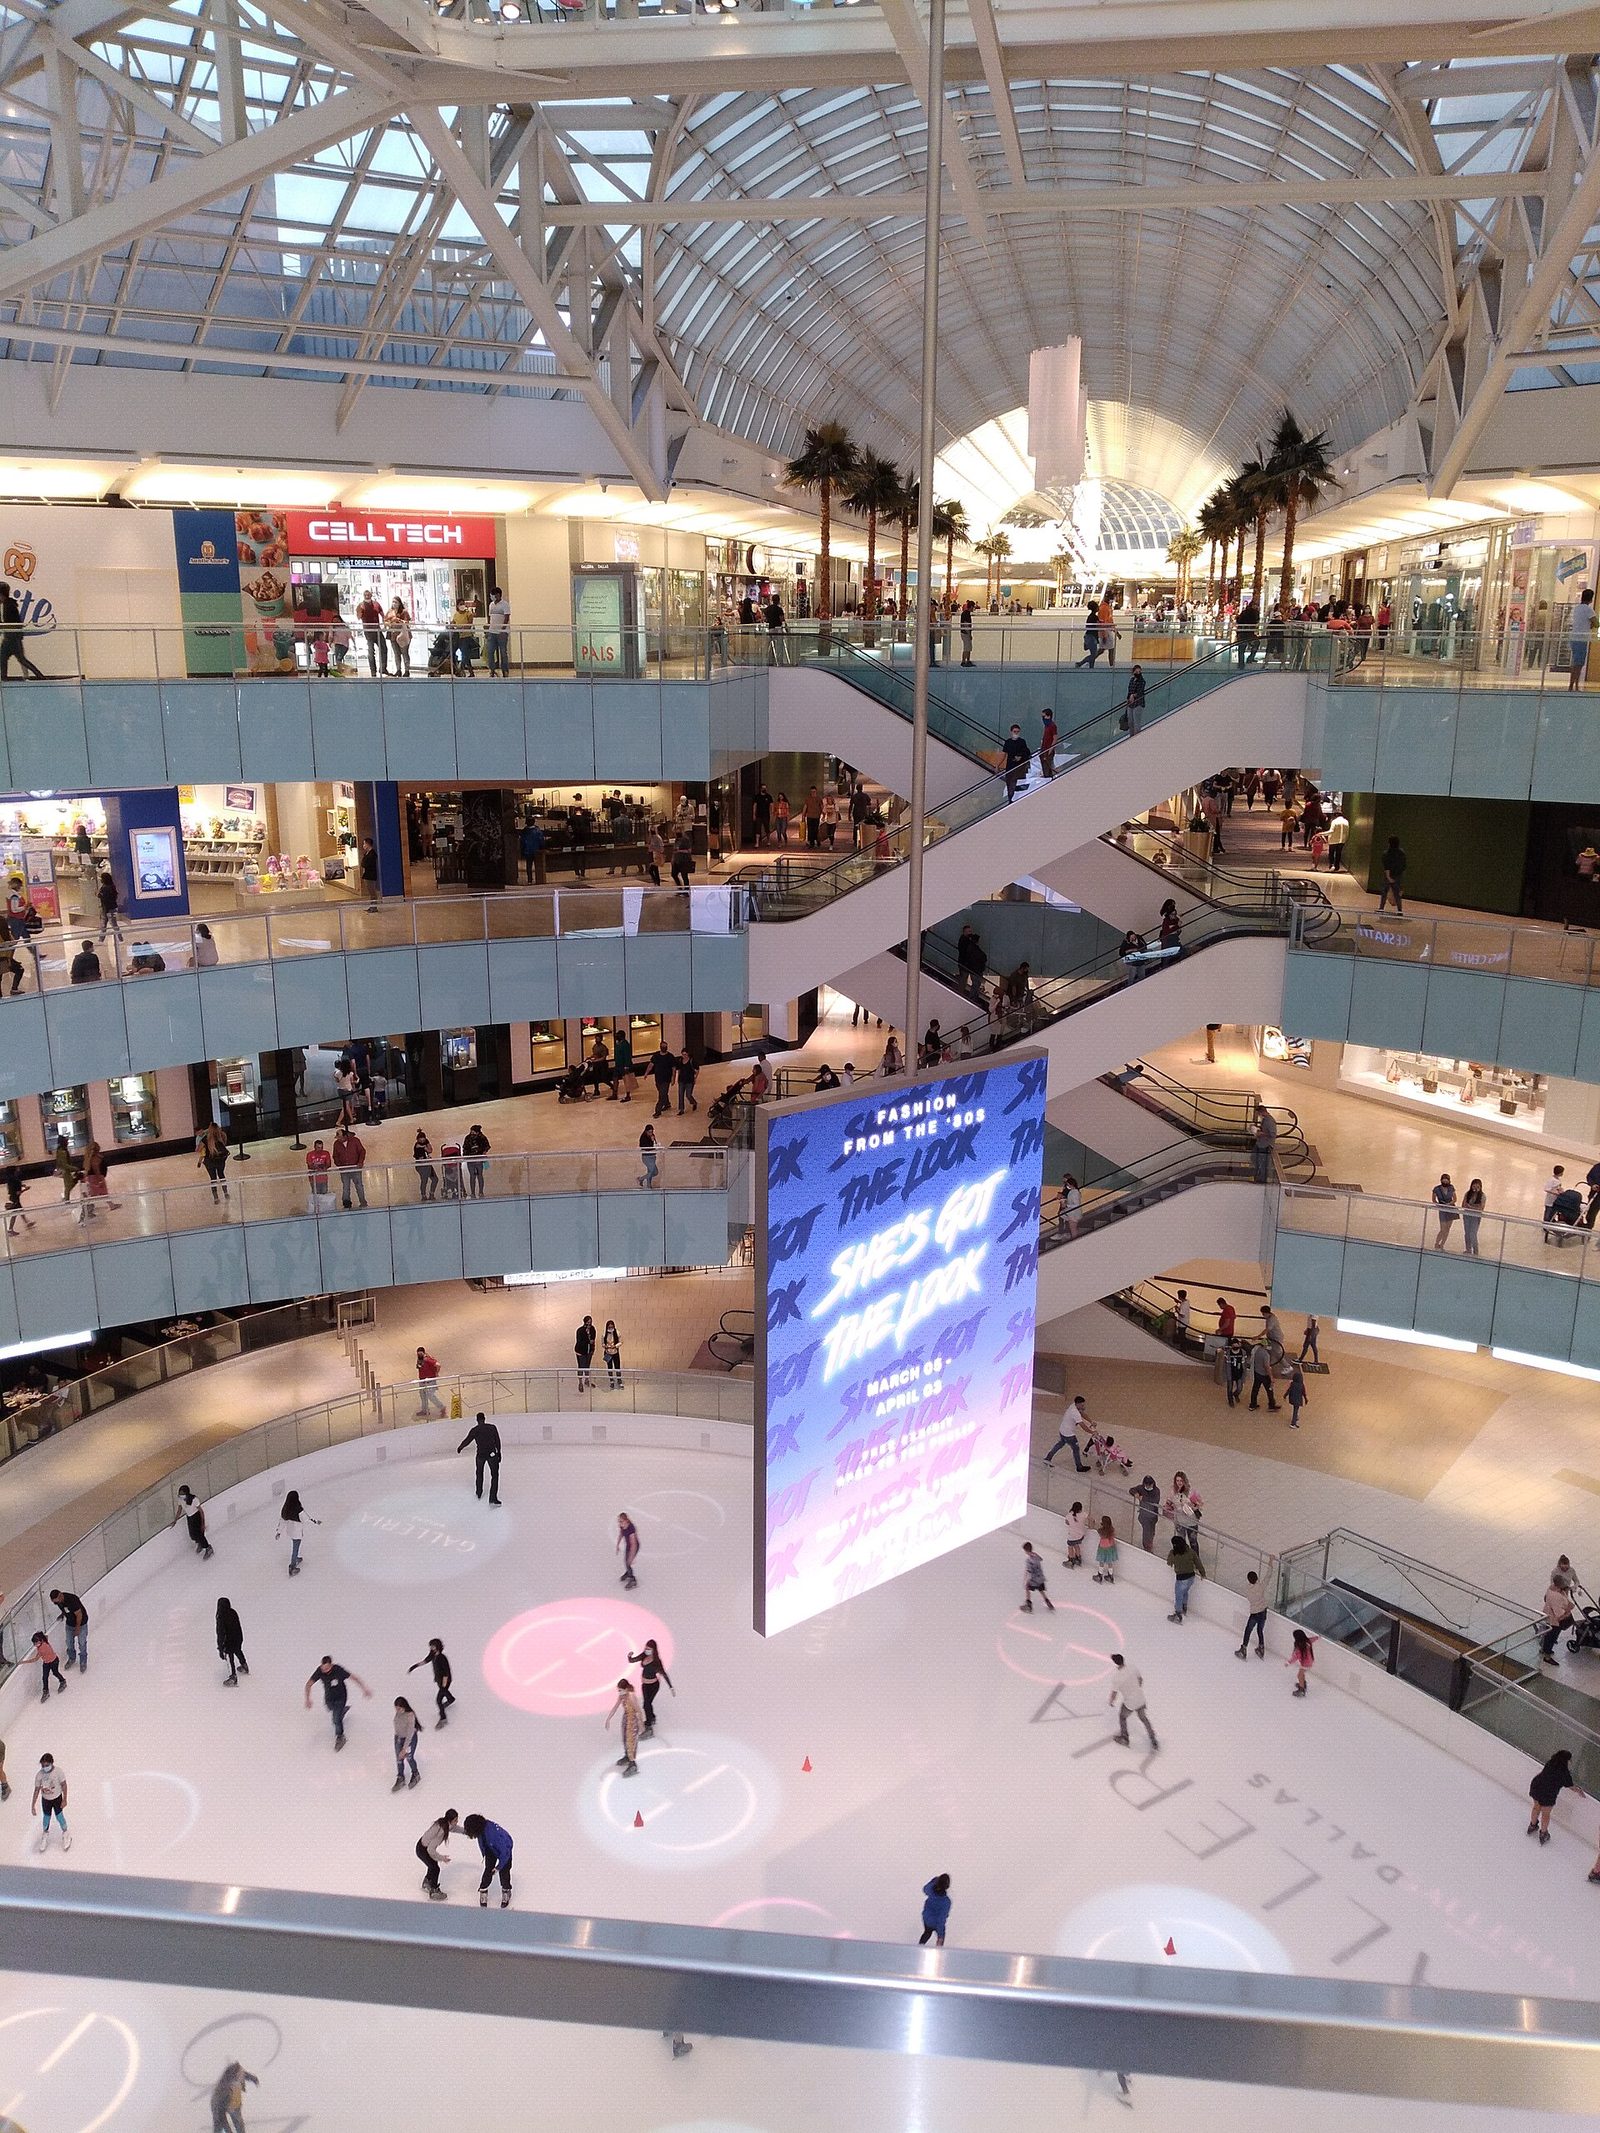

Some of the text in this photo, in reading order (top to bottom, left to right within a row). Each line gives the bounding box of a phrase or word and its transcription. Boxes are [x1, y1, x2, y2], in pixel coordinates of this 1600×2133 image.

[308, 520, 462, 544] CELL TECH
[581, 645, 615, 662] PALS
[876, 1094, 956, 1126] FASHION
[843, 1130, 895, 1156] FROM
[904, 1120, 937, 1142] THE
[838, 1124, 981, 1237] THE LOOK
[811, 1168, 1008, 1318] SHE'S GOT
[822, 1242, 988, 1384] THE LOOK
[866, 1365, 920, 1397] MARCH
[876, 1389, 920, 1417] APRIL
[1246, 1772, 1404, 1885] DALLAS
